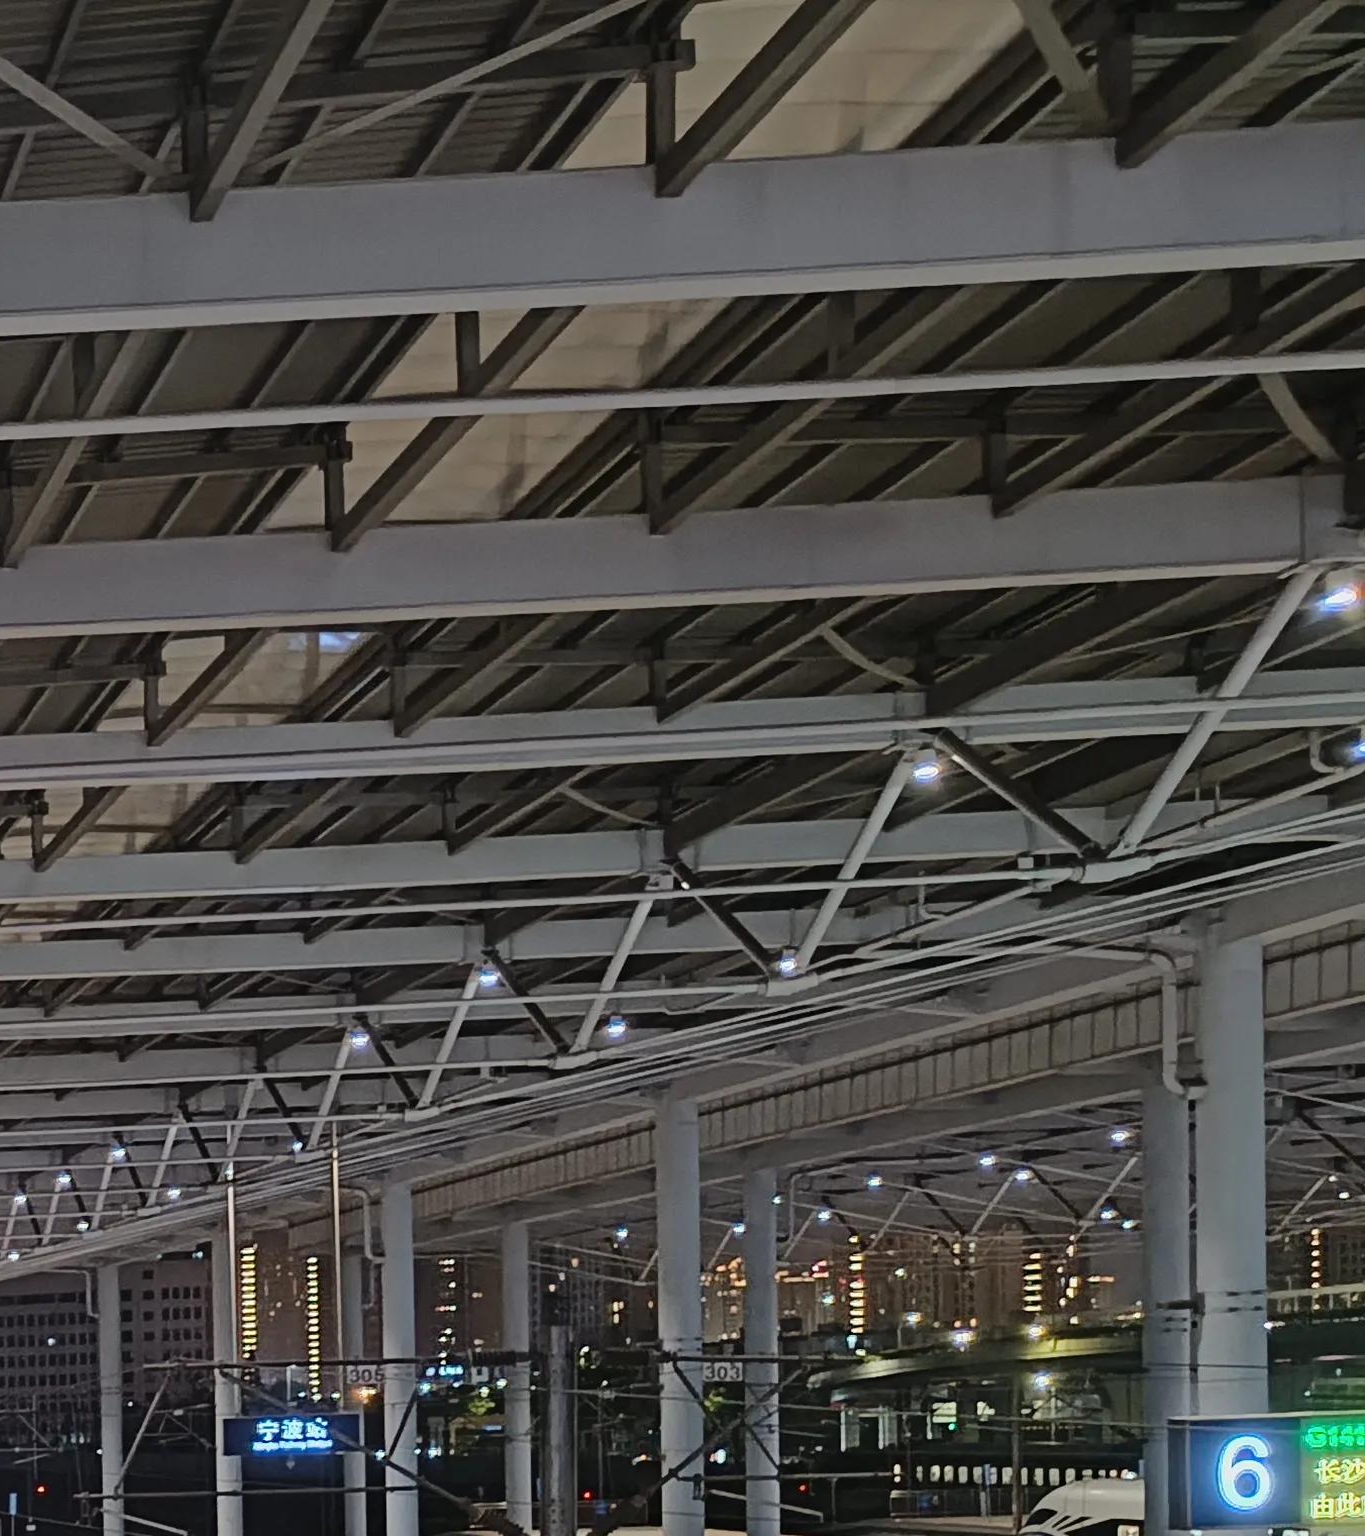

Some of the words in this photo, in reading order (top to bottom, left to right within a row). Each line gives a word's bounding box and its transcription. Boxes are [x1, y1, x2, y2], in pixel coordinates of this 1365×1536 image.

[705, 1366, 740, 1380] 303
[257, 1417, 328, 1441] 宁波站
[1218, 1434, 1272, 1512] 6
[1307, 1492, 1365, 1519] 由此
